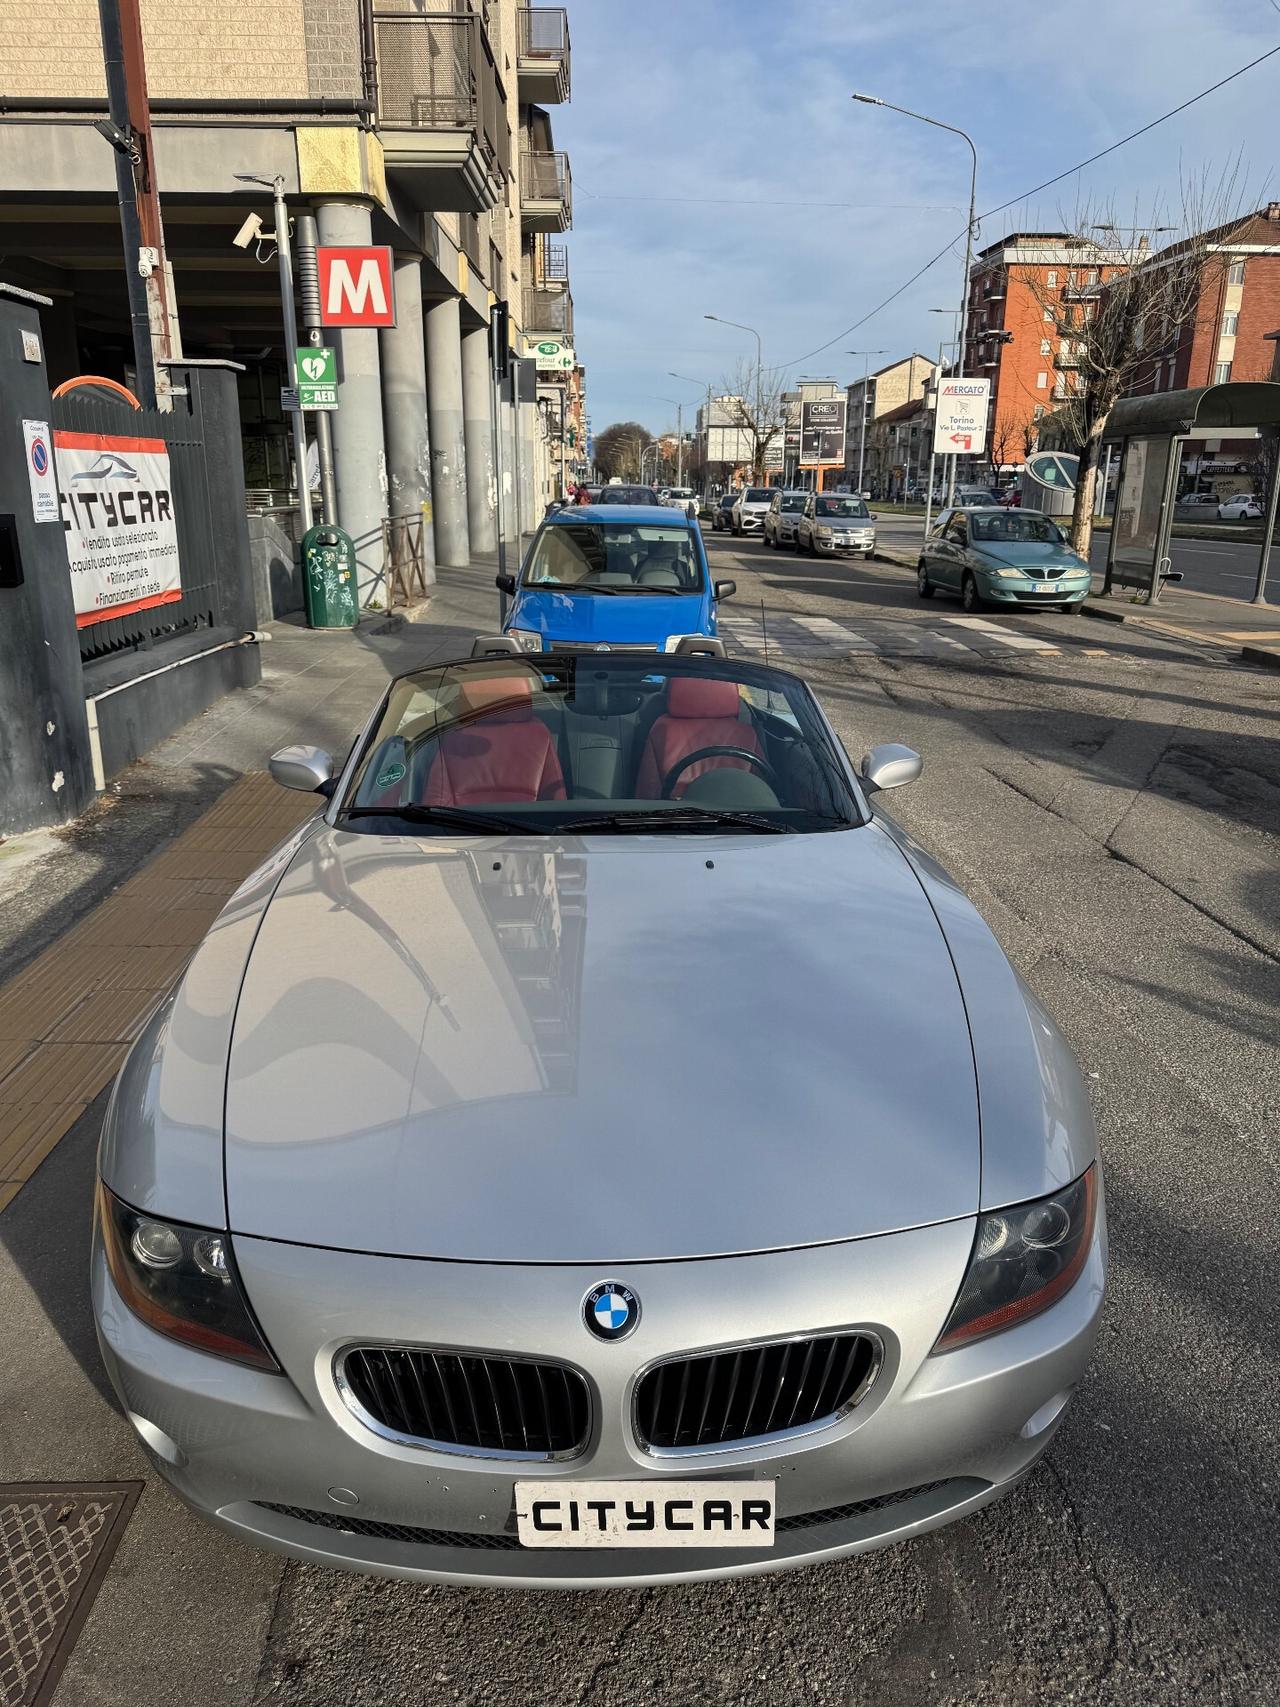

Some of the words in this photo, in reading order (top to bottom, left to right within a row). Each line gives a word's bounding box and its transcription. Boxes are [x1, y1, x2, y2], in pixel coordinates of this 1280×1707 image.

[327, 259, 388, 314] M
[313, 390, 336, 402] AED
[811, 405, 837, 413] CREO
[949, 415, 975, 424] Torino
[125, 529, 159, 545] selezionato
[98, 554, 117, 569] usato
[117, 549, 148, 568] pagamento
[147, 543, 177, 559] immediato
[110, 570, 126, 585] Ritiro
[127, 567, 149, 584] permute
[99, 586, 140, 606] Finanziamenti
[140, 583, 147, 596] in
[147, 581, 160, 593] sede
[589, 1284, 634, 1303] BMW
[532, 1500, 772, 1532] CITYCAR
